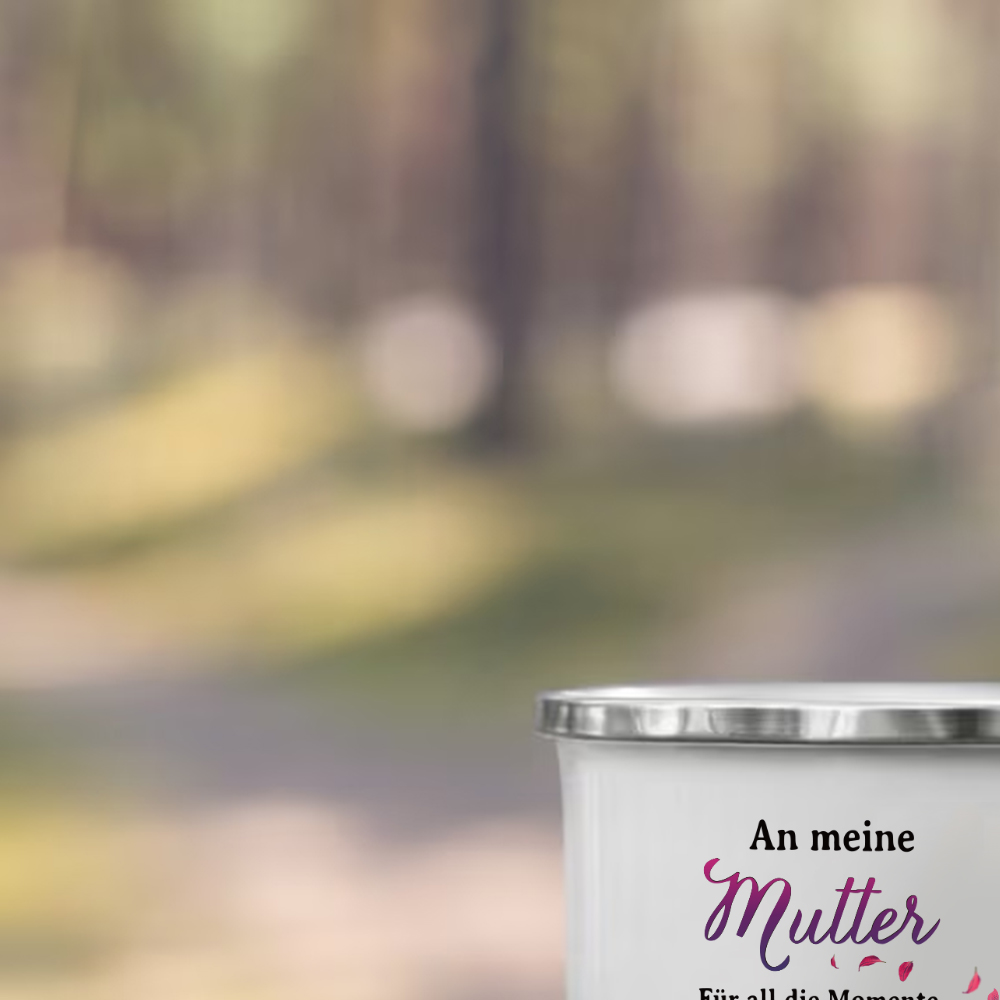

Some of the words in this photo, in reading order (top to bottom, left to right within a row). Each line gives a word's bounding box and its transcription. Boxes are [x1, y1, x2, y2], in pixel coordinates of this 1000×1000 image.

[750, 819, 798, 850] An
[811, 820, 914, 852] meine
[704, 858, 940, 971] Mutter
